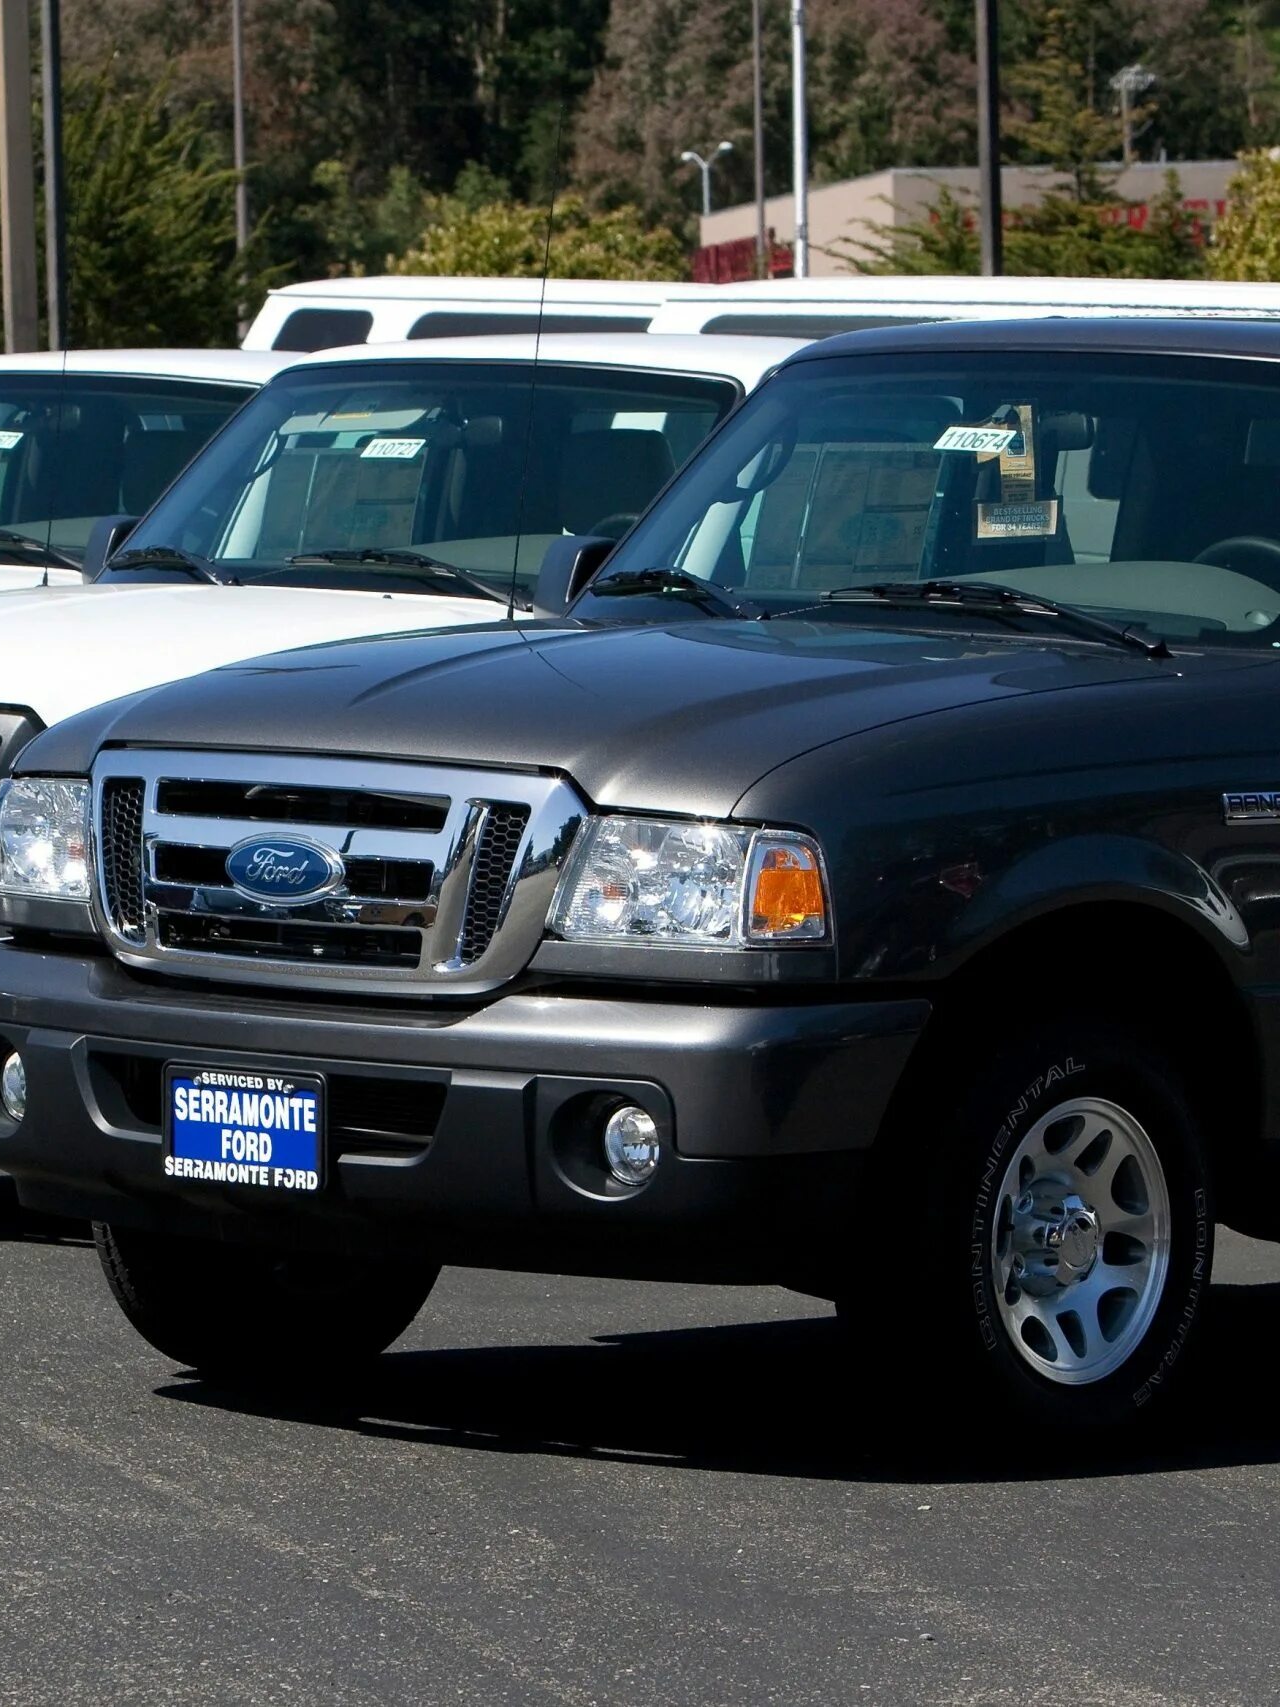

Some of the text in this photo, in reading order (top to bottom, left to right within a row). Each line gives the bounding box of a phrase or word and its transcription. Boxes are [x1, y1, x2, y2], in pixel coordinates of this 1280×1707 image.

[942, 431, 1010, 450] 110674
[986, 515, 1012, 524] BRAND
[1023, 514, 1050, 522] TRUCKS
[245, 848, 309, 884] Ford
[202, 1072, 284, 1091] SERVICED BY
[174, 1087, 316, 1132] SERRAMONTE
[222, 1129, 272, 1162] FORD
[164, 1156, 318, 1190] SERRAMONTE FORD
[970, 1056, 1086, 1351] CONTINENTAL
